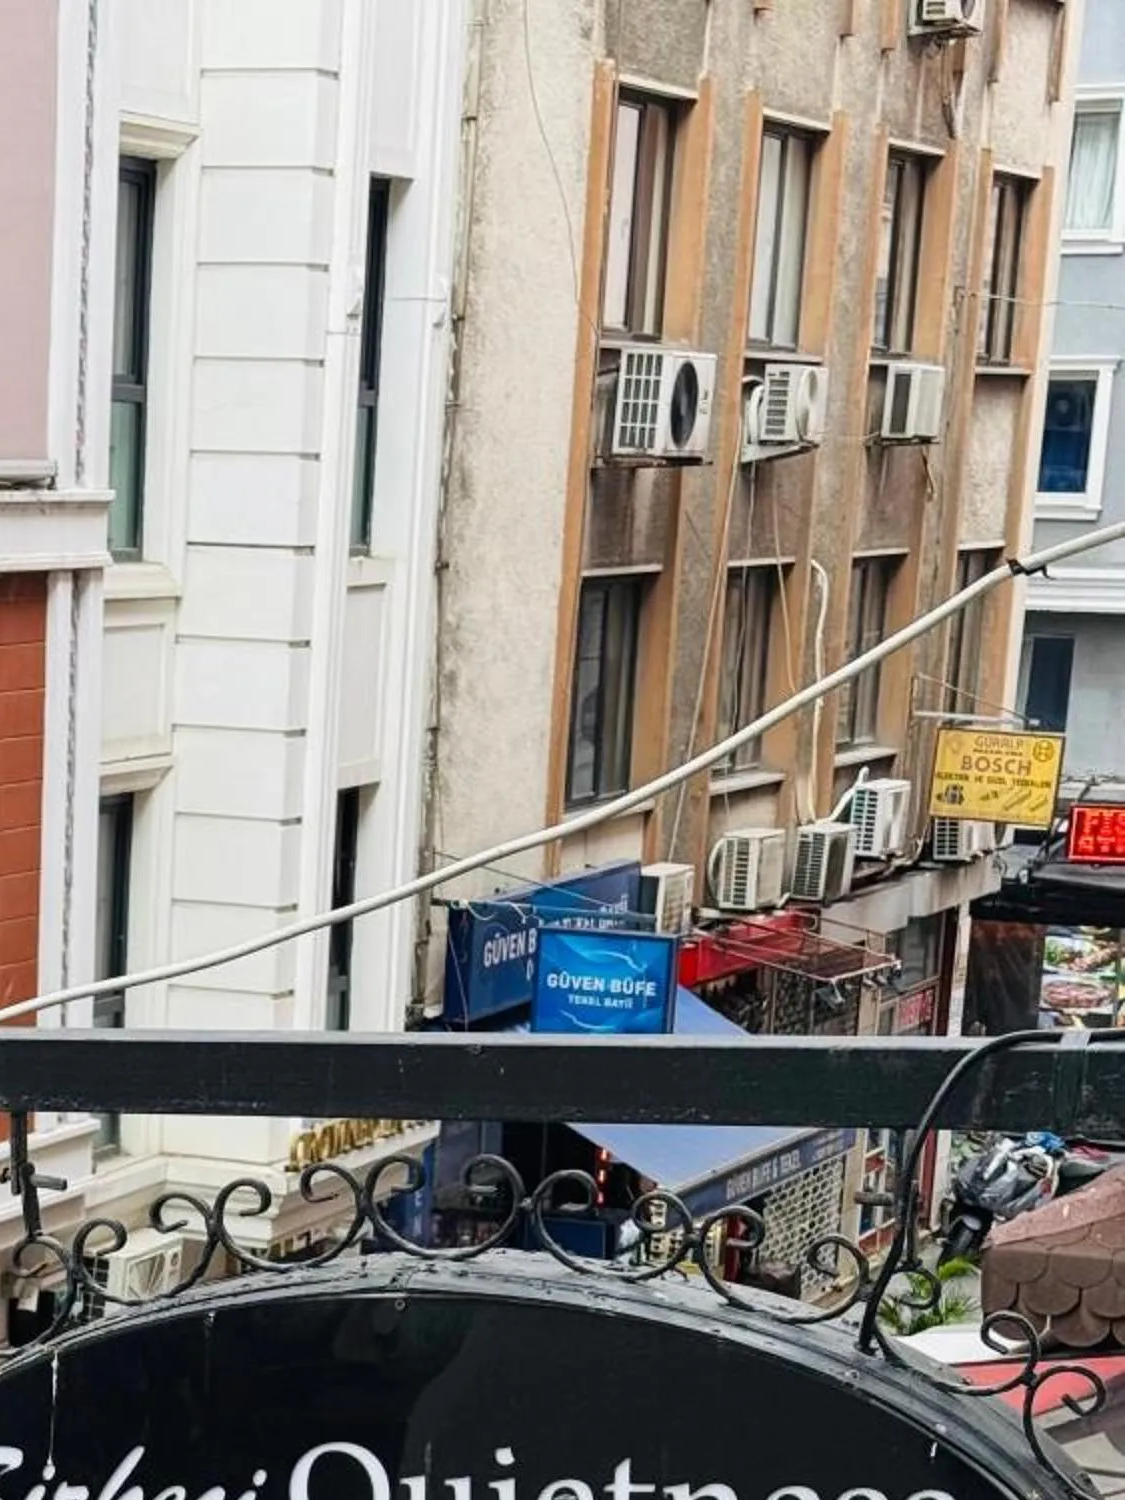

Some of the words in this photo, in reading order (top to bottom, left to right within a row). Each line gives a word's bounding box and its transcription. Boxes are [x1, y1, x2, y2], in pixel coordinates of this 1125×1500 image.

[960, 755, 1032, 777] BOSCH
[482, 928, 526, 969] GÜVEN
[546, 970, 605, 993] GÜVEN
[609, 974, 657, 998] BÜFE
